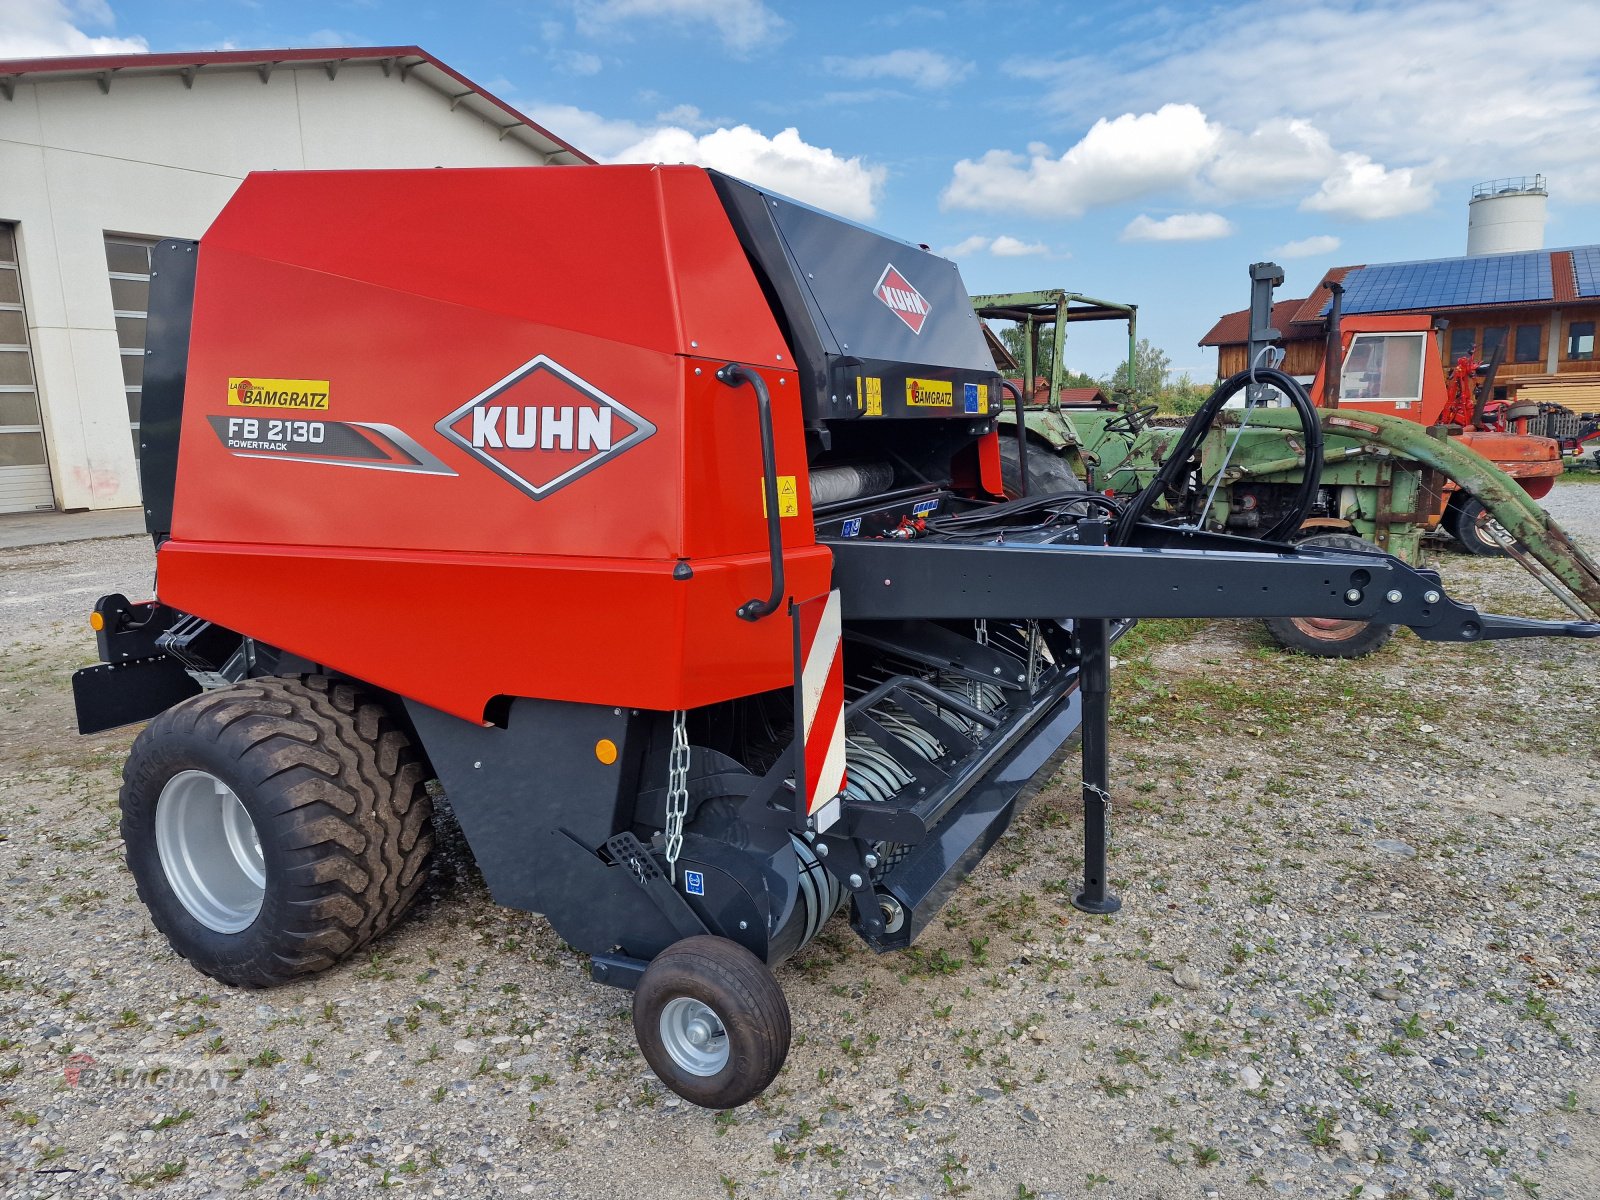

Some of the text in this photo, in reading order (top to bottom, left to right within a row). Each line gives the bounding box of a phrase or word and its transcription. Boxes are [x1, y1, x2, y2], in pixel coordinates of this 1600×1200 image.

[881, 285, 927, 315] KUHN
[242, 390, 327, 408] BAMGRATZ
[914, 390, 951, 405] BAMGRATZ
[228, 418, 325, 443] FB 2130
[472, 406, 612, 451] KUHN
[228, 439, 288, 451] POWERTRACK
